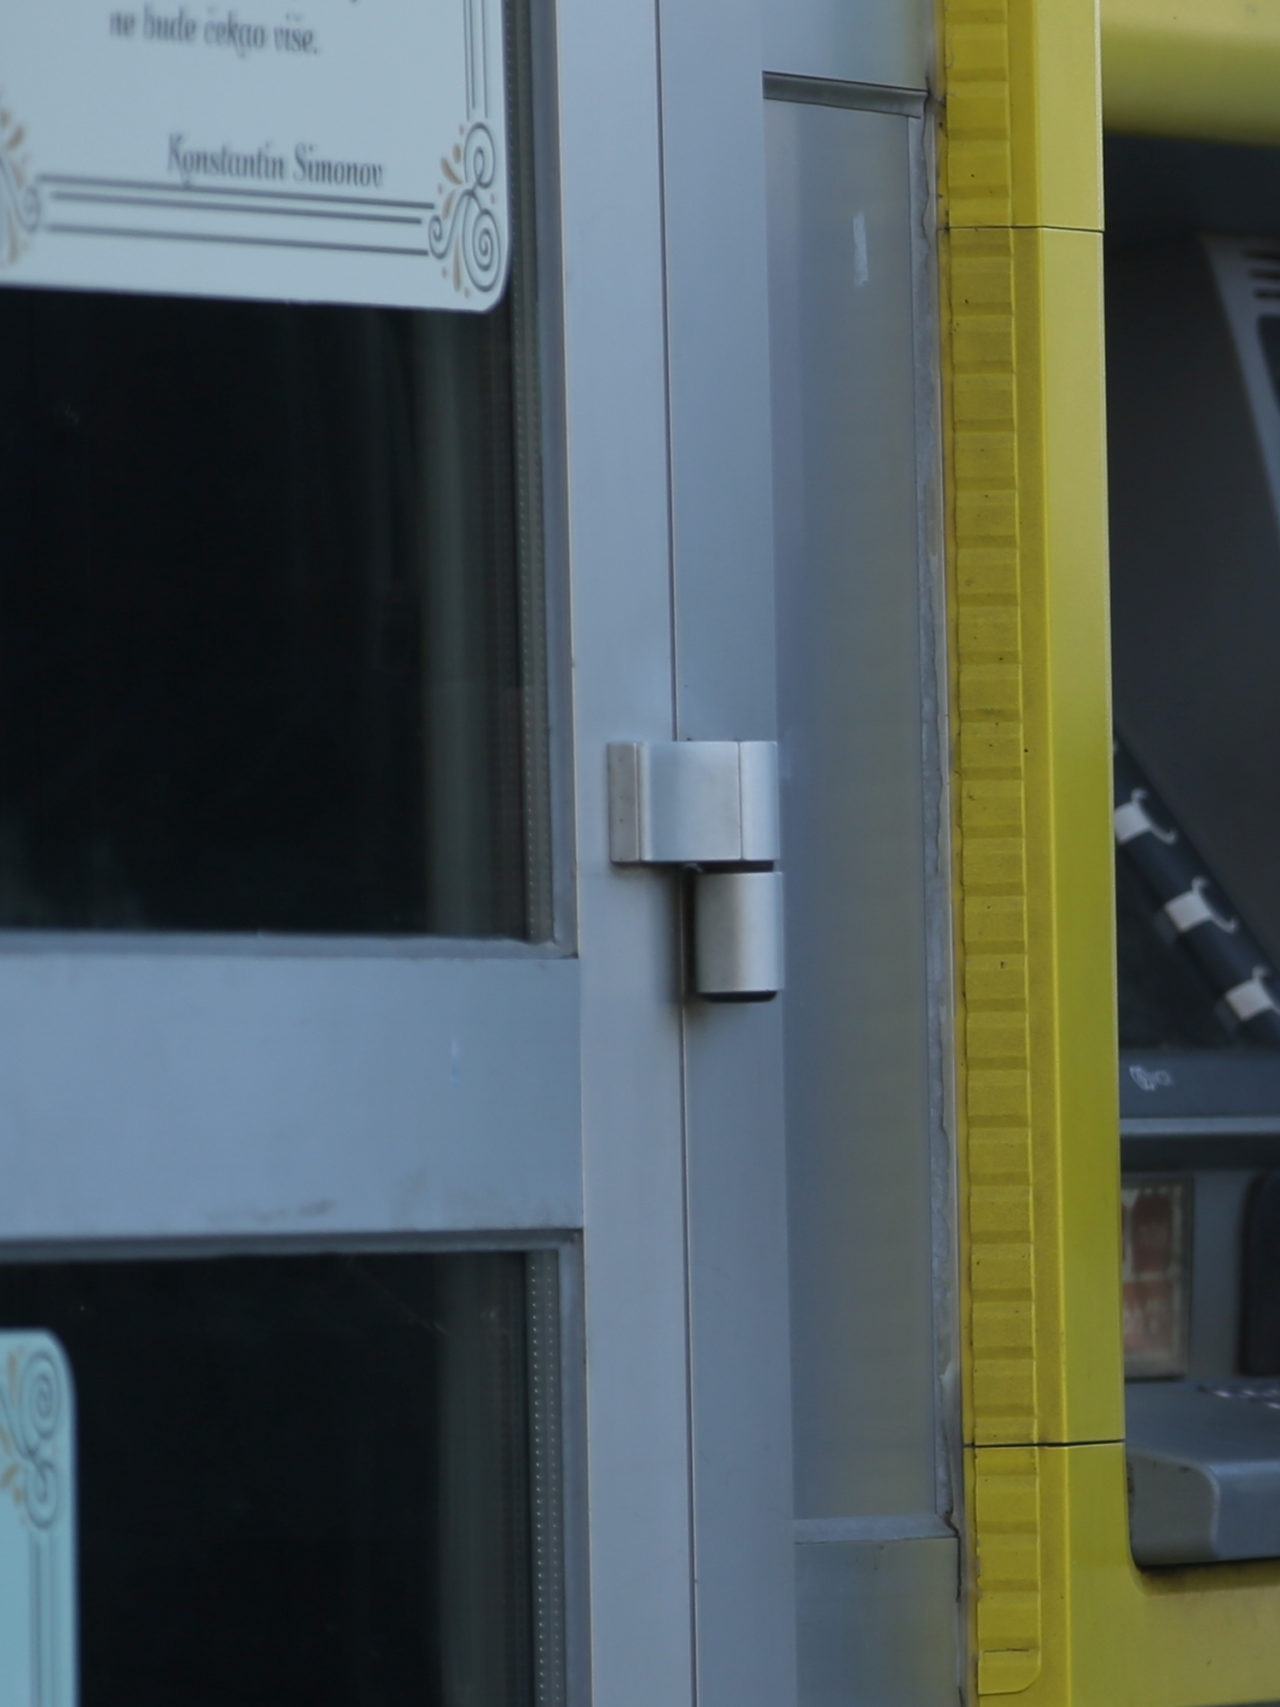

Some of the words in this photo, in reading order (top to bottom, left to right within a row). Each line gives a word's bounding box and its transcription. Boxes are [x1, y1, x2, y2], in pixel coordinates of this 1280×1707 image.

[109, 12, 135, 38] ne
[143, 2, 196, 41] bude
[168, 132, 285, 187] Konstantin
[292, 141, 383, 188] Simonov
